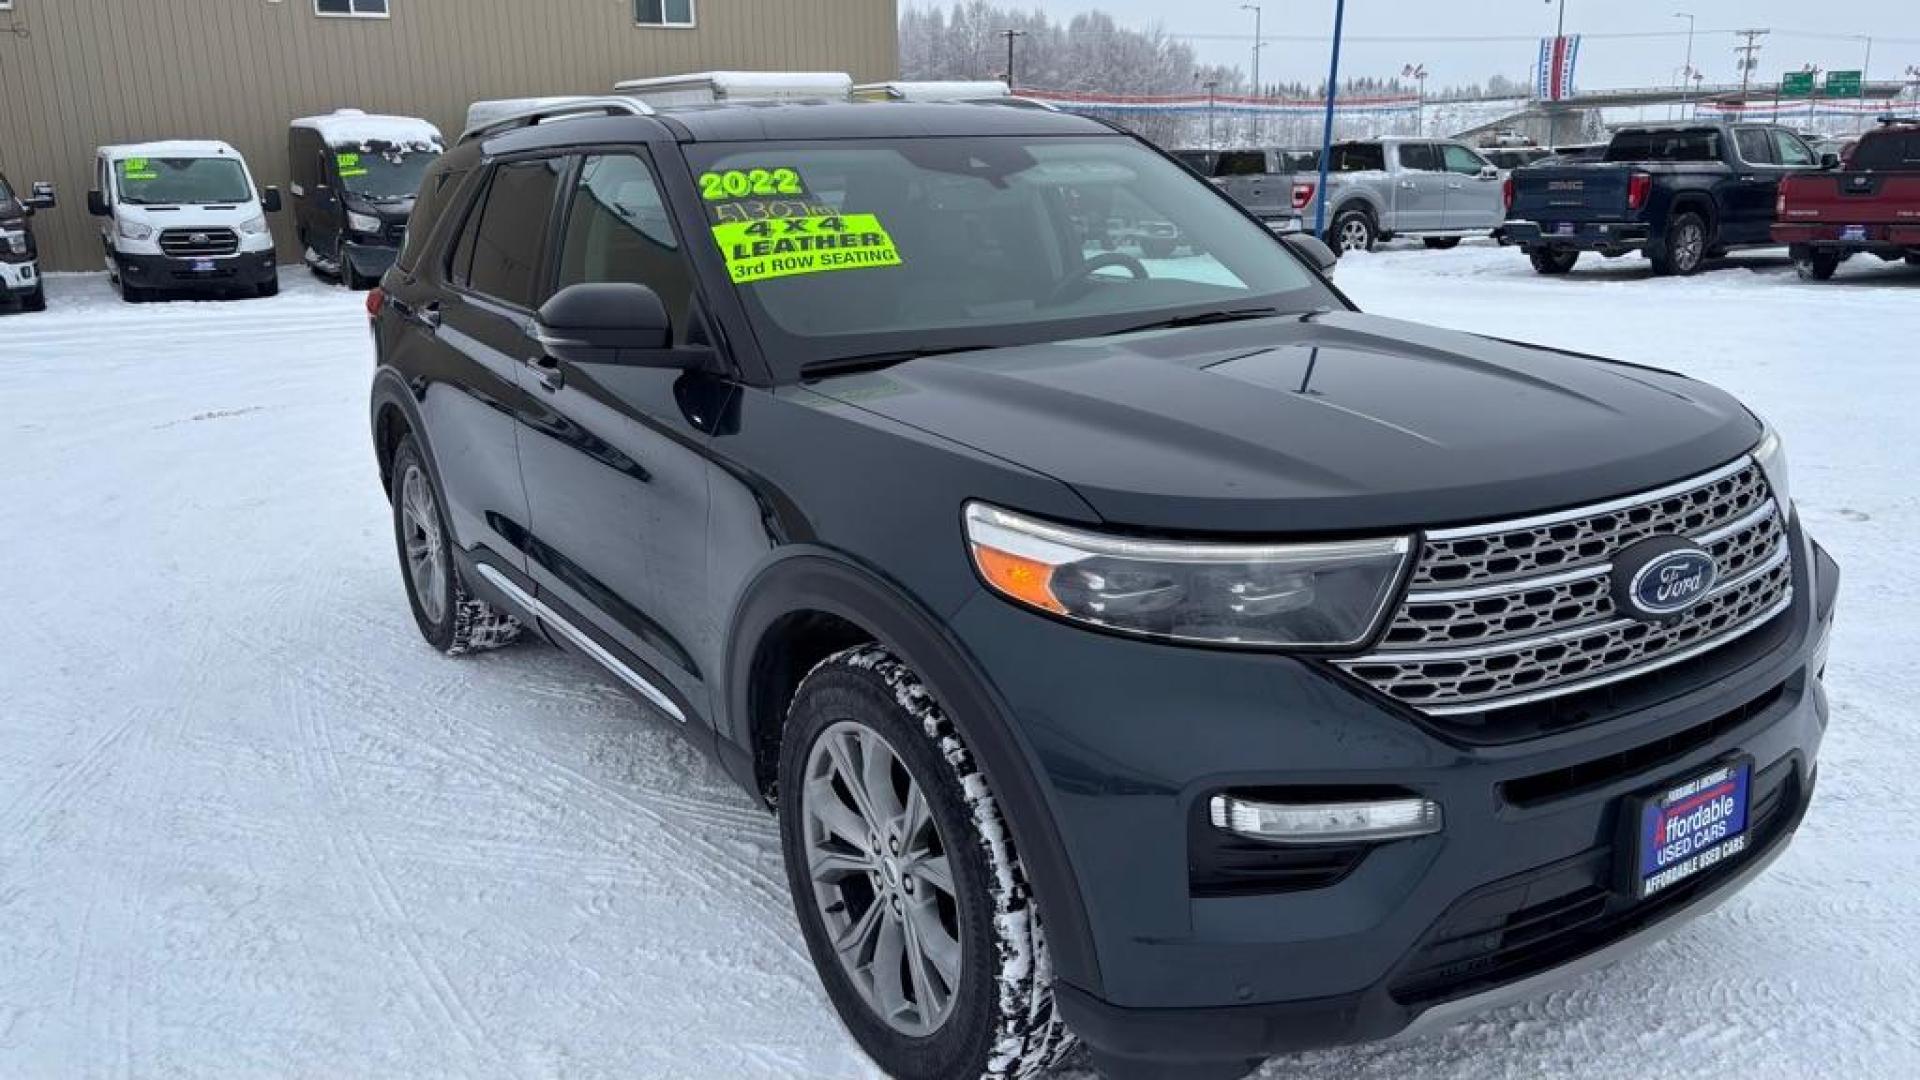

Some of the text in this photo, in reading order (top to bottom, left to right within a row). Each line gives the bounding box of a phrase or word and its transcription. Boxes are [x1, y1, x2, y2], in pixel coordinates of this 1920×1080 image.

[700, 168, 803, 200] 2022
[744, 220, 772, 237] 4
[818, 216, 848, 232] 4
[732, 232, 884, 260] LEATHER
[734, 248, 894, 278] 3rd ROW SEATING
[1657, 563, 1701, 601] Ford
[1654, 795, 1734, 850] Affordable
[1657, 820, 1727, 865] USED CARS
